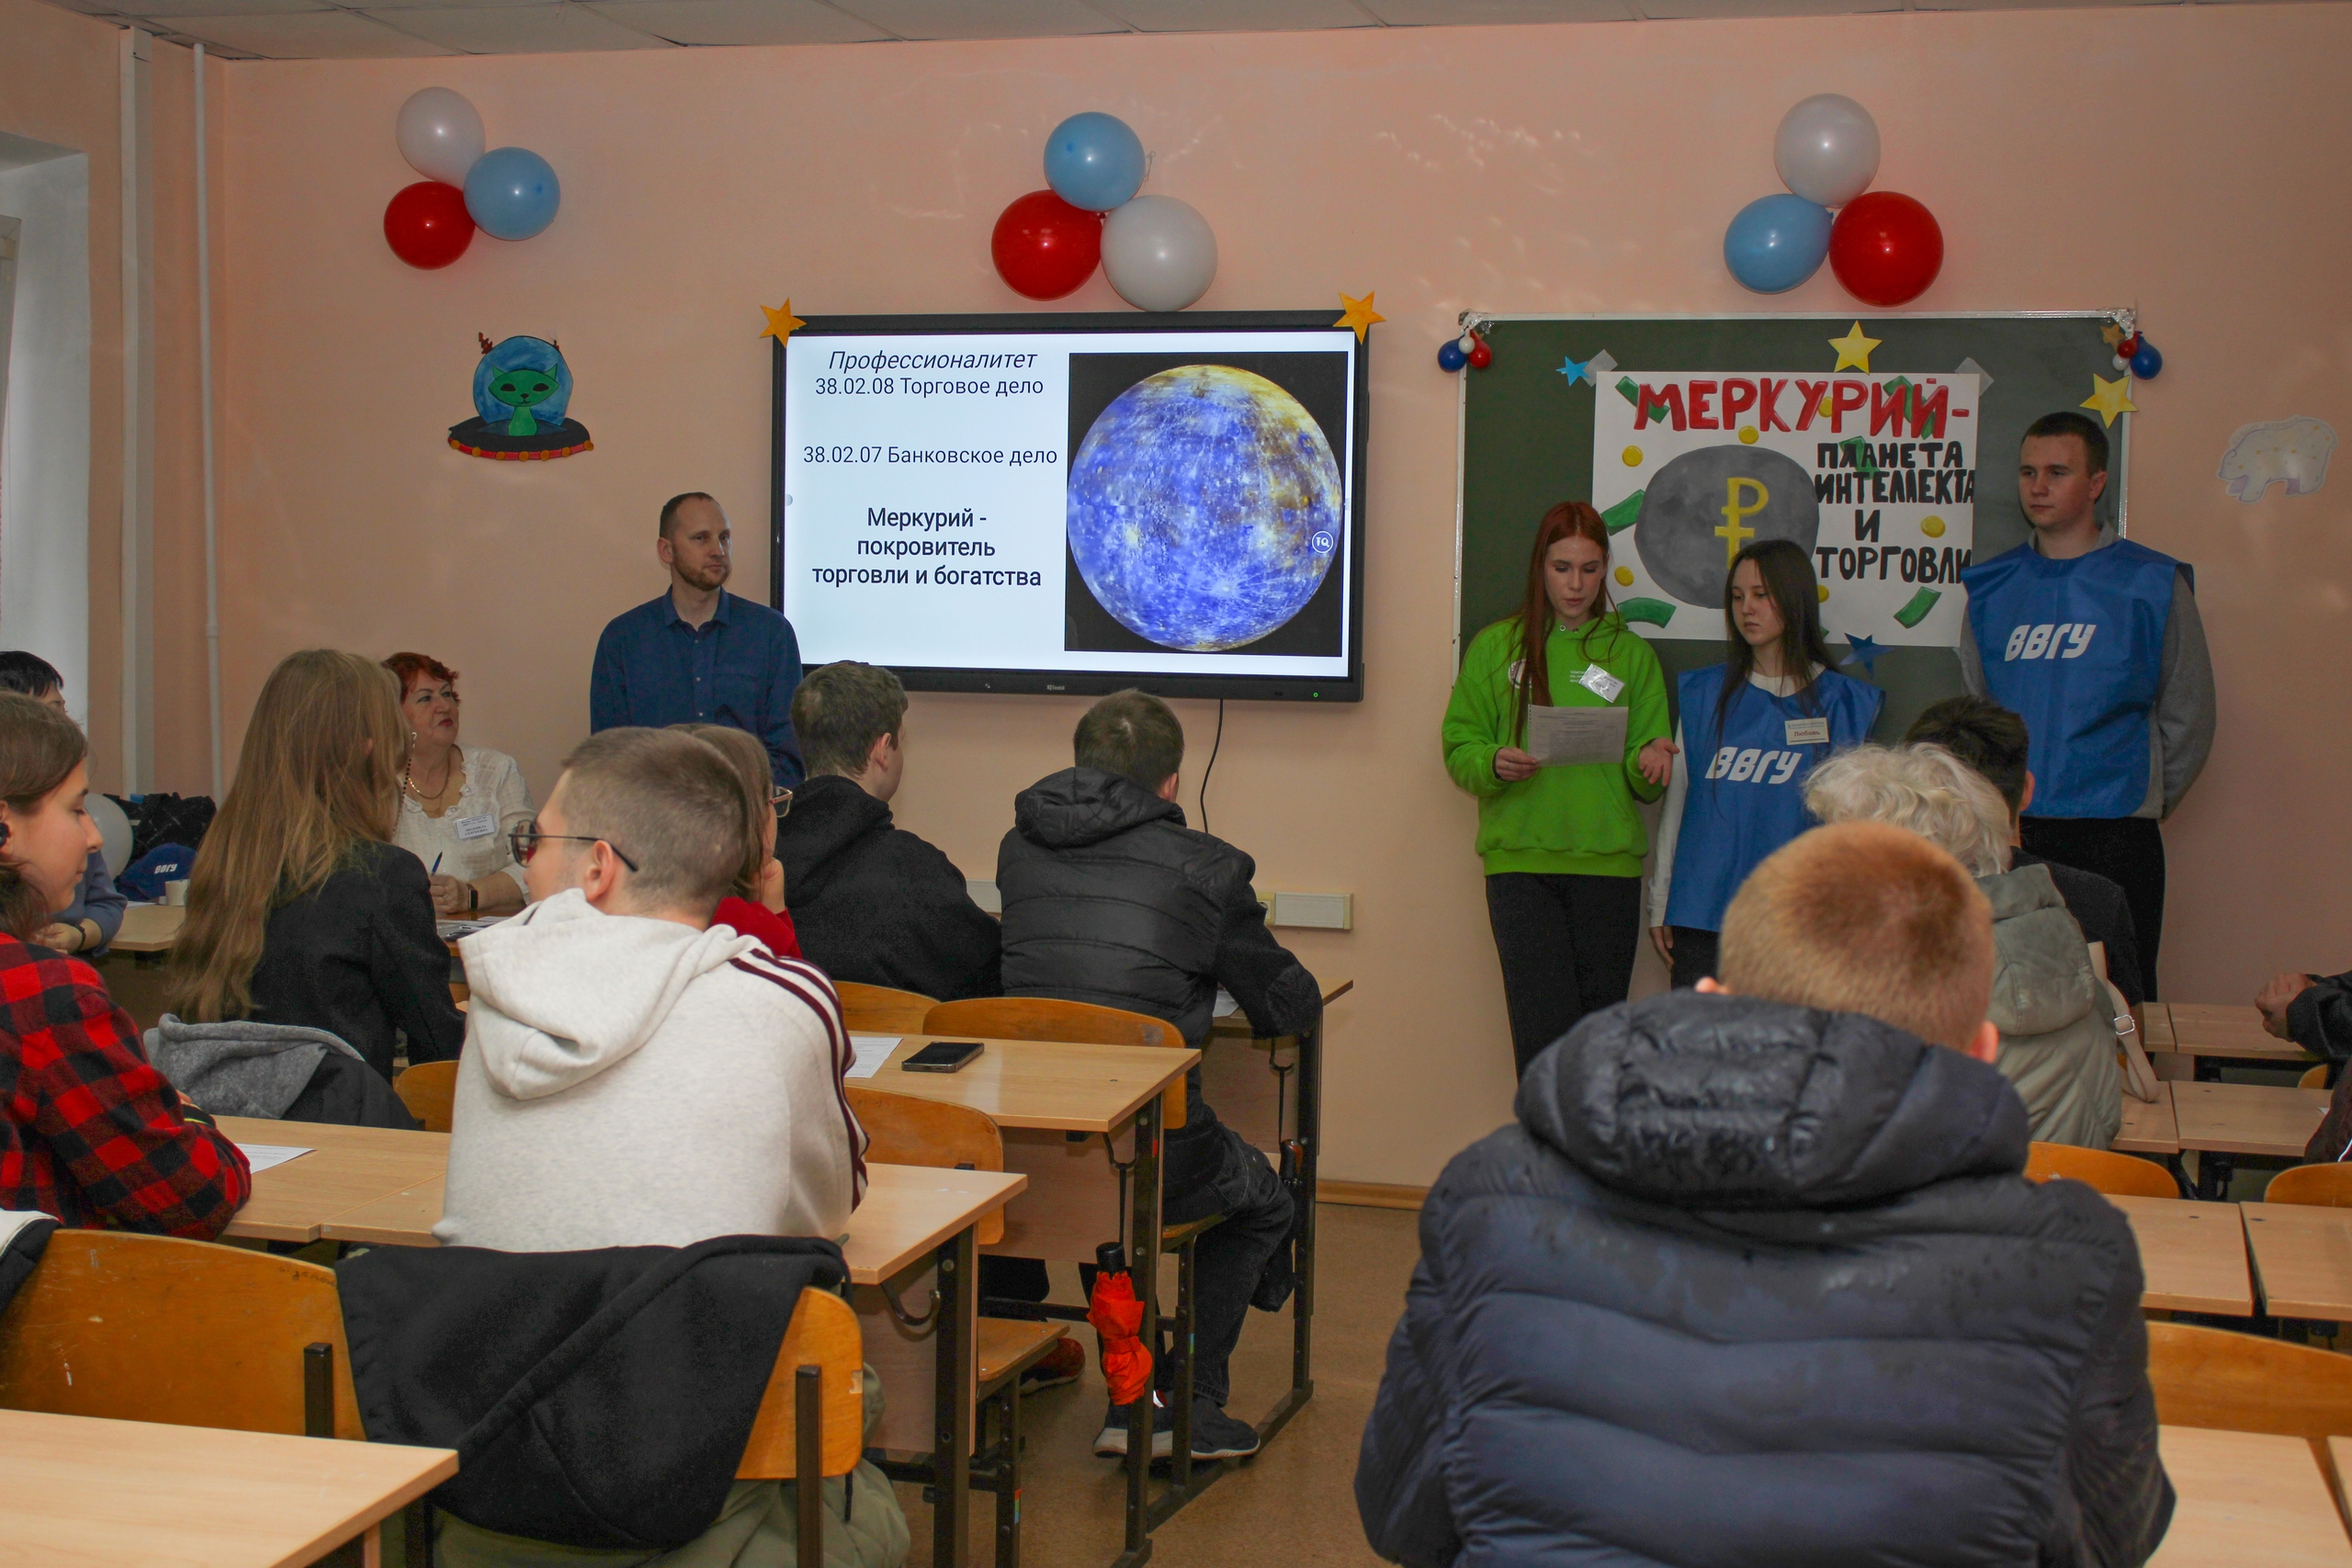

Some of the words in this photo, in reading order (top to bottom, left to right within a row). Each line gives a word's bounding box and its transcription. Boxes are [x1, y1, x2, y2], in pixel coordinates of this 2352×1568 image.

[829, 350, 1037, 374] Профессионалитет
[816, 378, 894, 394] 38.02.08
[900, 378, 990, 398] Торговое
[995, 380, 1044, 397] дело
[804, 446, 882, 463] 38.02.07
[888, 446, 1004, 463] Банковское
[1009, 449, 1057, 467] дело
[1817, 441, 1963, 468] ПЛАНЕТА
[1815, 469, 1975, 504] ИНТЕЛЛЕКТА
[867, 507, 974, 531] Меркурий
[1855, 509, 1880, 543] И
[857, 540, 996, 559] покровитель
[812, 568, 909, 588] торговли
[916, 570, 927, 583] и
[934, 565, 1041, 586] богатства
[1815, 546, 1972, 584] ТОРГОВЛИ
[2005, 624, 2097, 661] ВВГУ
[1704, 747, 1803, 784] ВВГУ
[154, 863, 178, 874] ВВГУ
